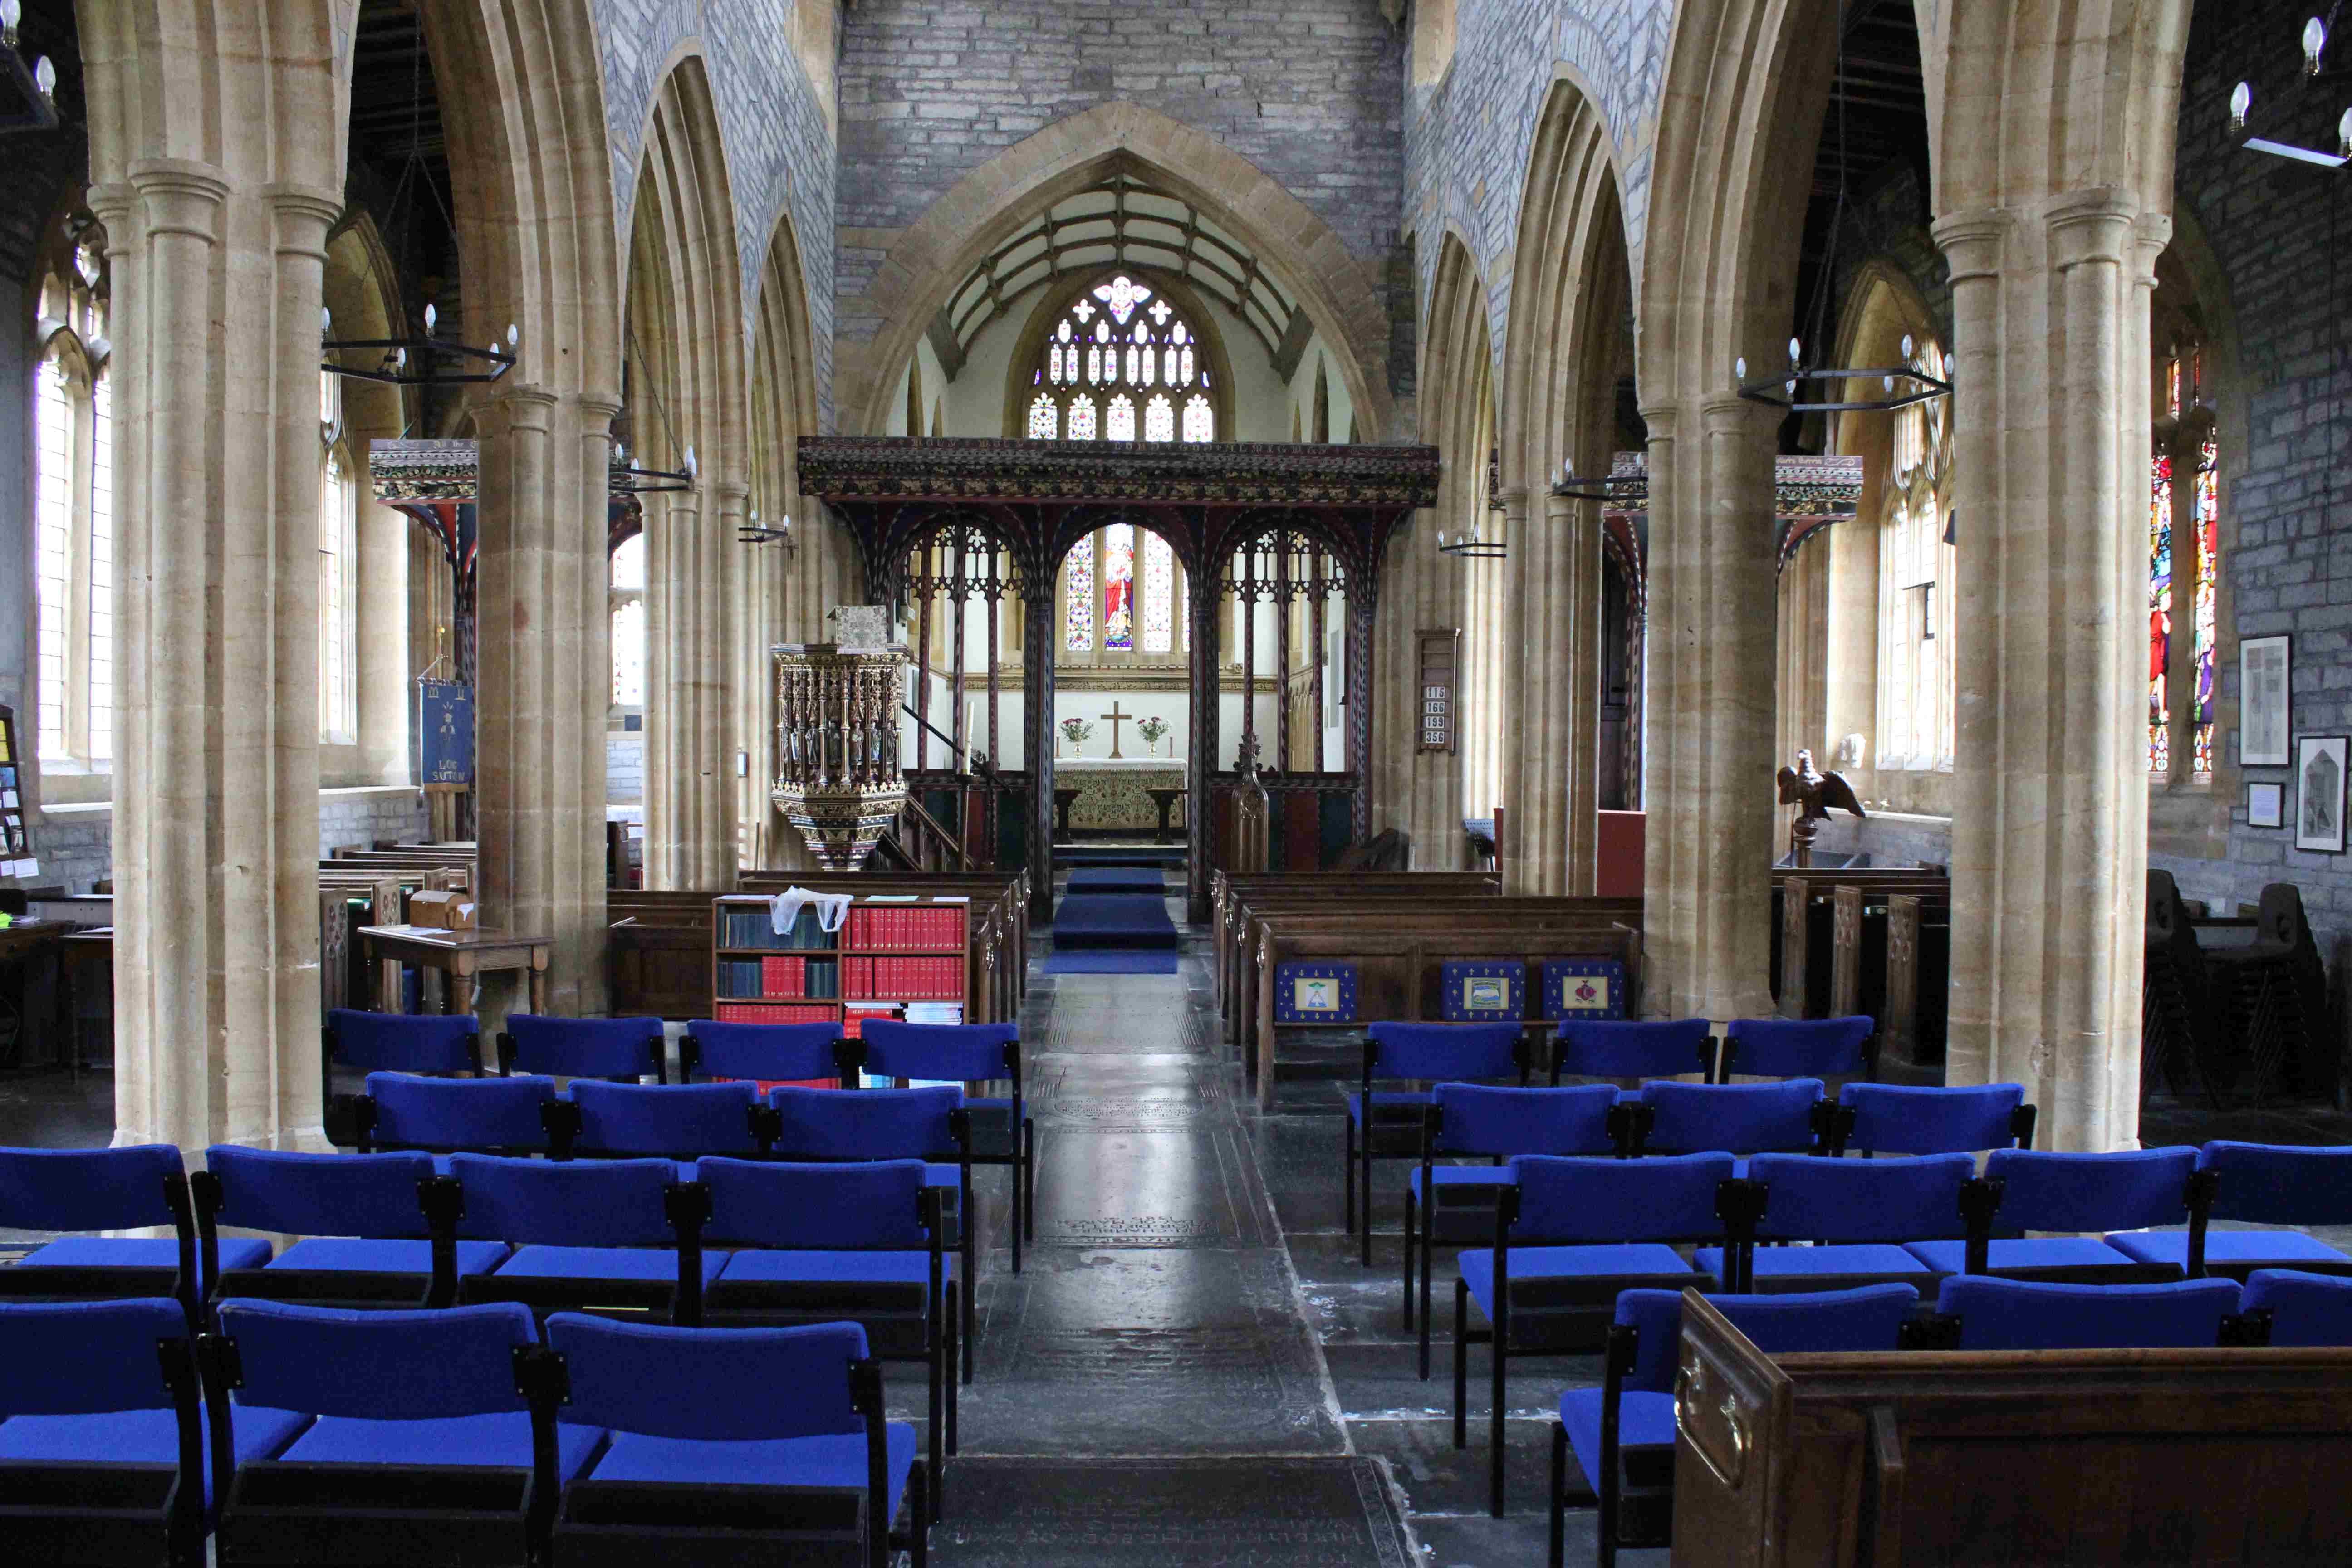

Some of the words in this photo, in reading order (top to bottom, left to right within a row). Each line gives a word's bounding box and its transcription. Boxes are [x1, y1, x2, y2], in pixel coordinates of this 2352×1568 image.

[1428, 687, 1444, 697] 115
[1428, 702, 1444, 712] 166
[1427, 717, 1444, 727] 199
[1426, 732, 1444, 742] 356
